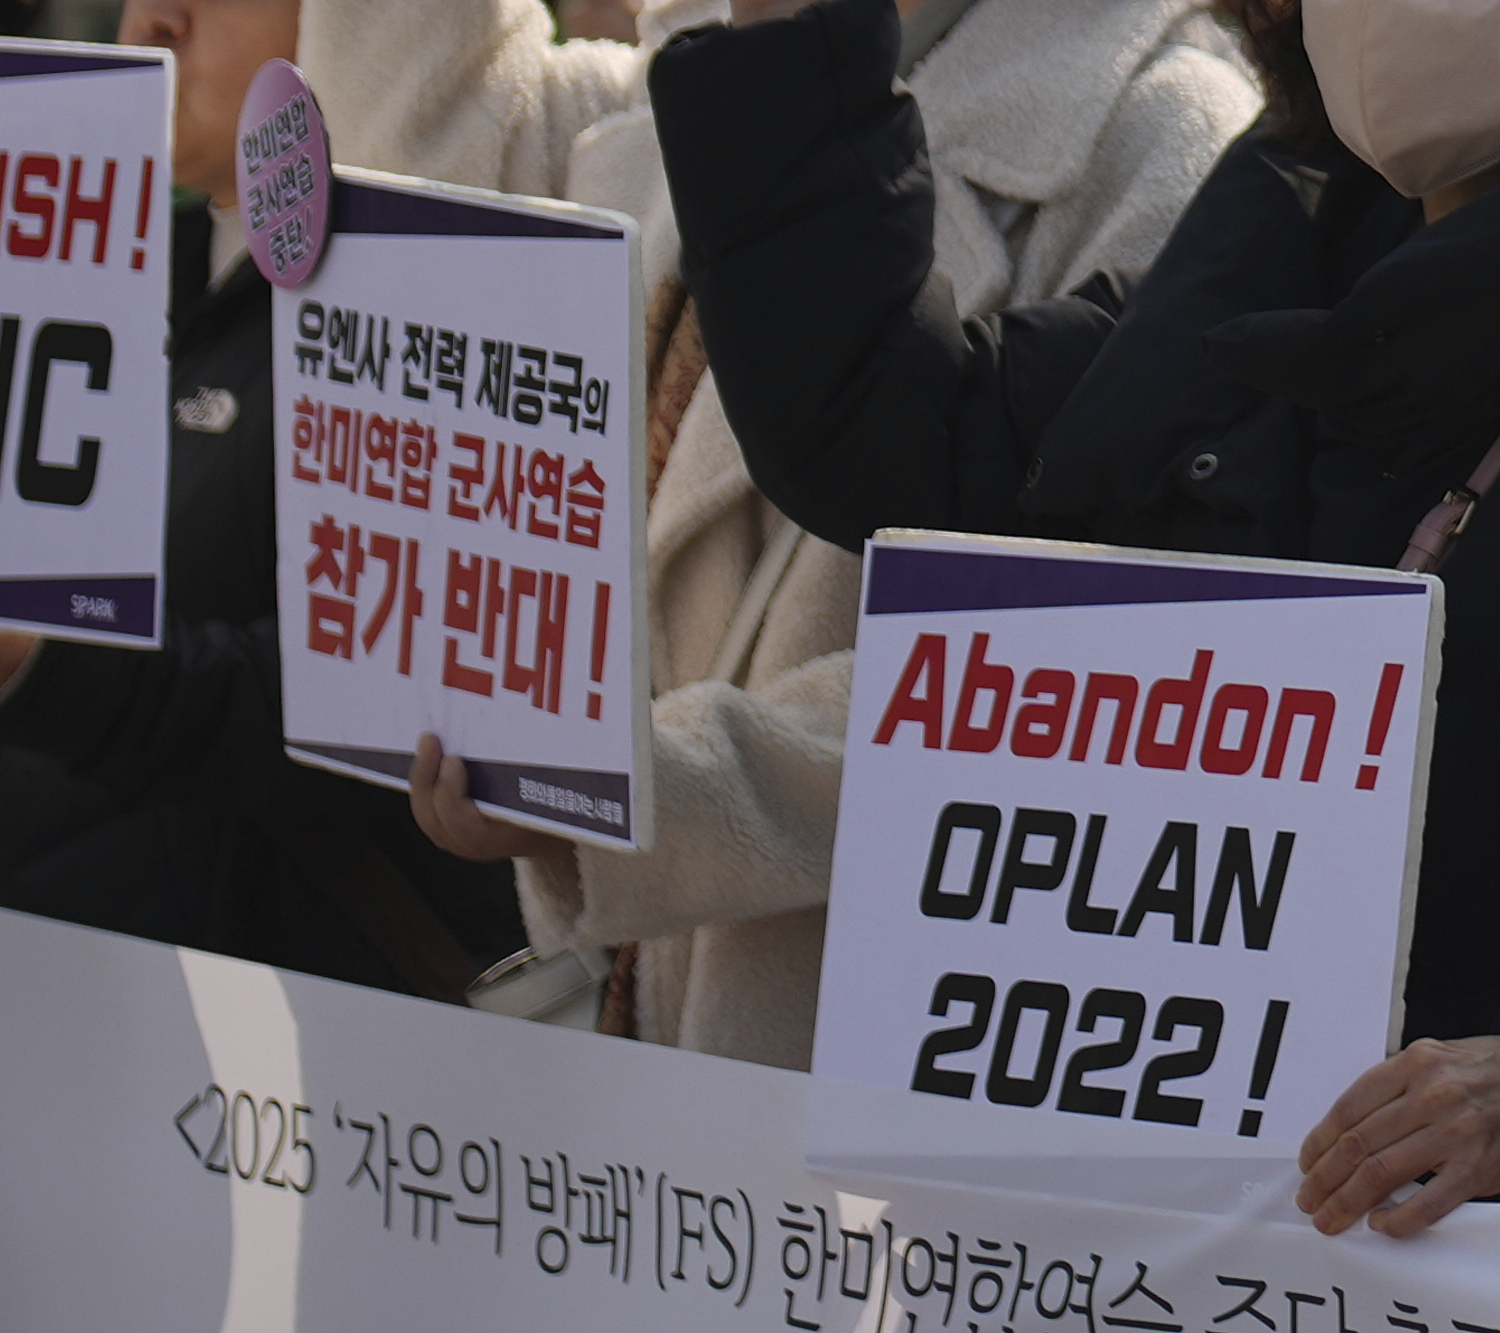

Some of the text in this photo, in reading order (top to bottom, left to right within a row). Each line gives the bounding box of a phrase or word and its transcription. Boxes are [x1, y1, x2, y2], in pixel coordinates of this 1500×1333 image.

[241, 94, 309, 175] 한미연합
[247, 152, 314, 232] 군사연습
[270, 205, 313, 273] 중단!
[293, 298, 610, 435] 유엔사 전력 제공국의
[291, 393, 606, 550] 한미연합 군사연습
[305, 513, 423, 677] 참가
[918, 801, 1296, 951] OPLAN
[173, 1082, 318, 1195] <2025
